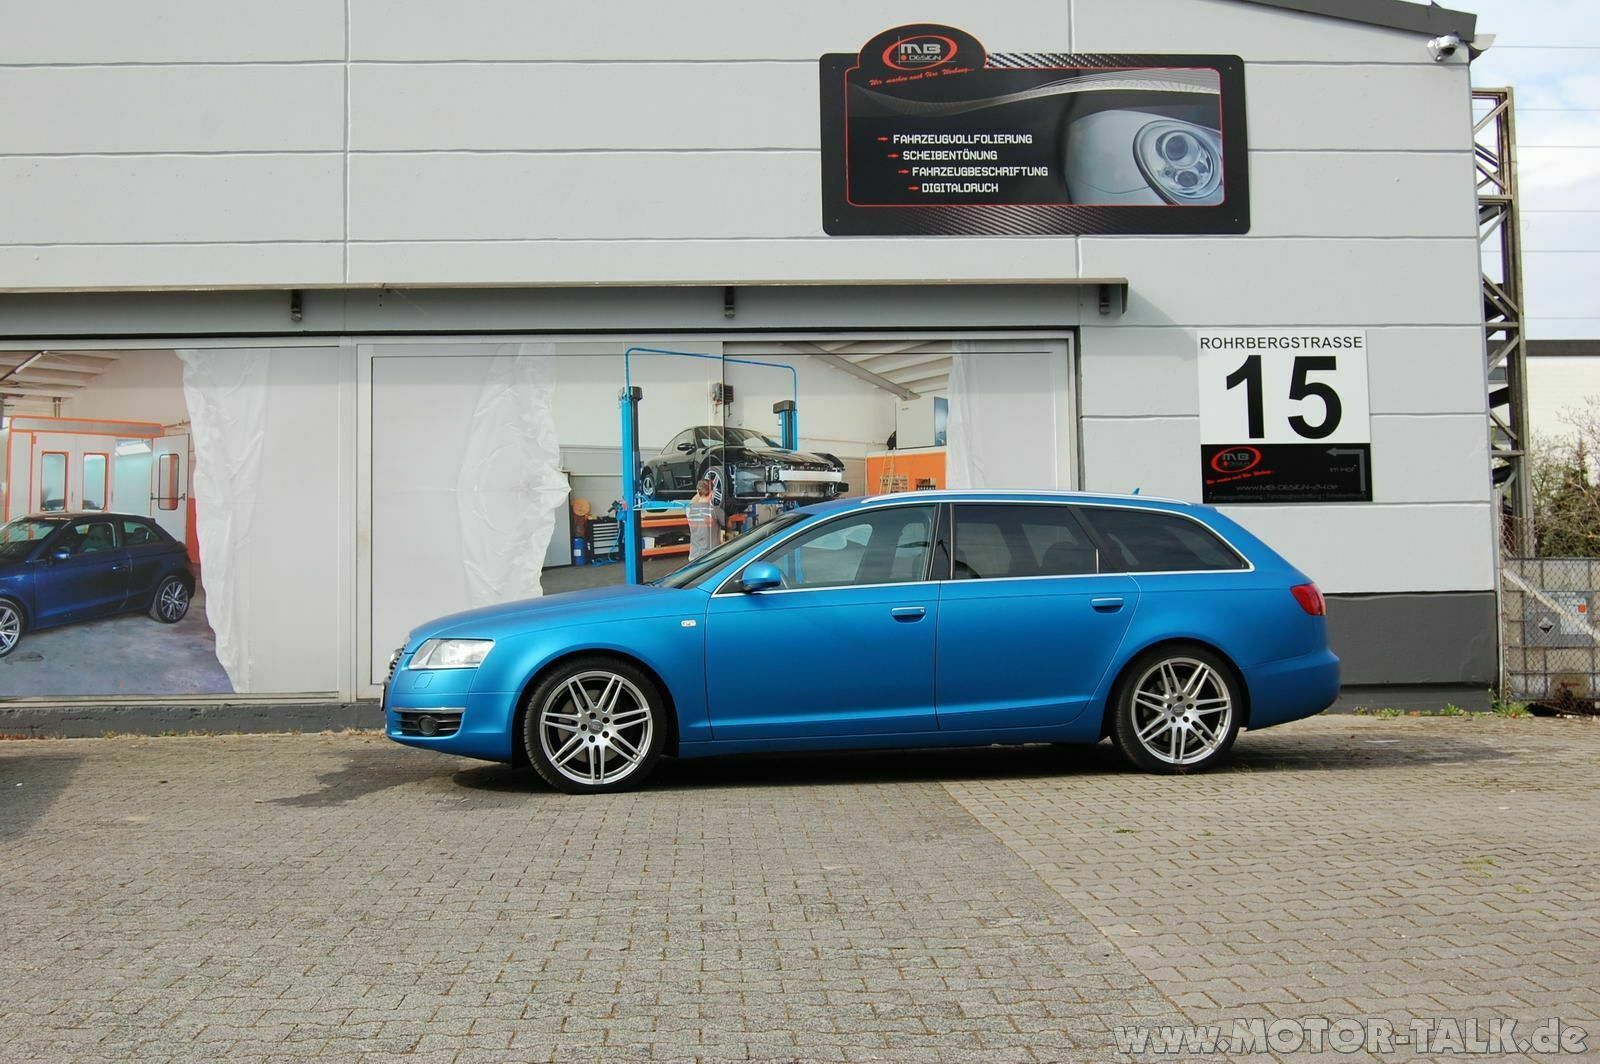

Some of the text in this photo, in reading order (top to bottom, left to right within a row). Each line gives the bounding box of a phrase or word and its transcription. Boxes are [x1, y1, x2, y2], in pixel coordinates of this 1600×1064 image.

[901, 43, 941, 54] MB
[893, 134, 1033, 144] FAHRZEUGVOLLFOLIERUNG
[903, 149, 998, 160] SCHEIBENTÖNUNG
[912, 166, 1048, 177] FAHRZEUGBESCHRIFTUNG
[921, 183, 999, 193] DIGITALDRUCK
[1200, 336, 1363, 349] ROHRBERGSTRASSE
[1226, 355, 1342, 439] 15
